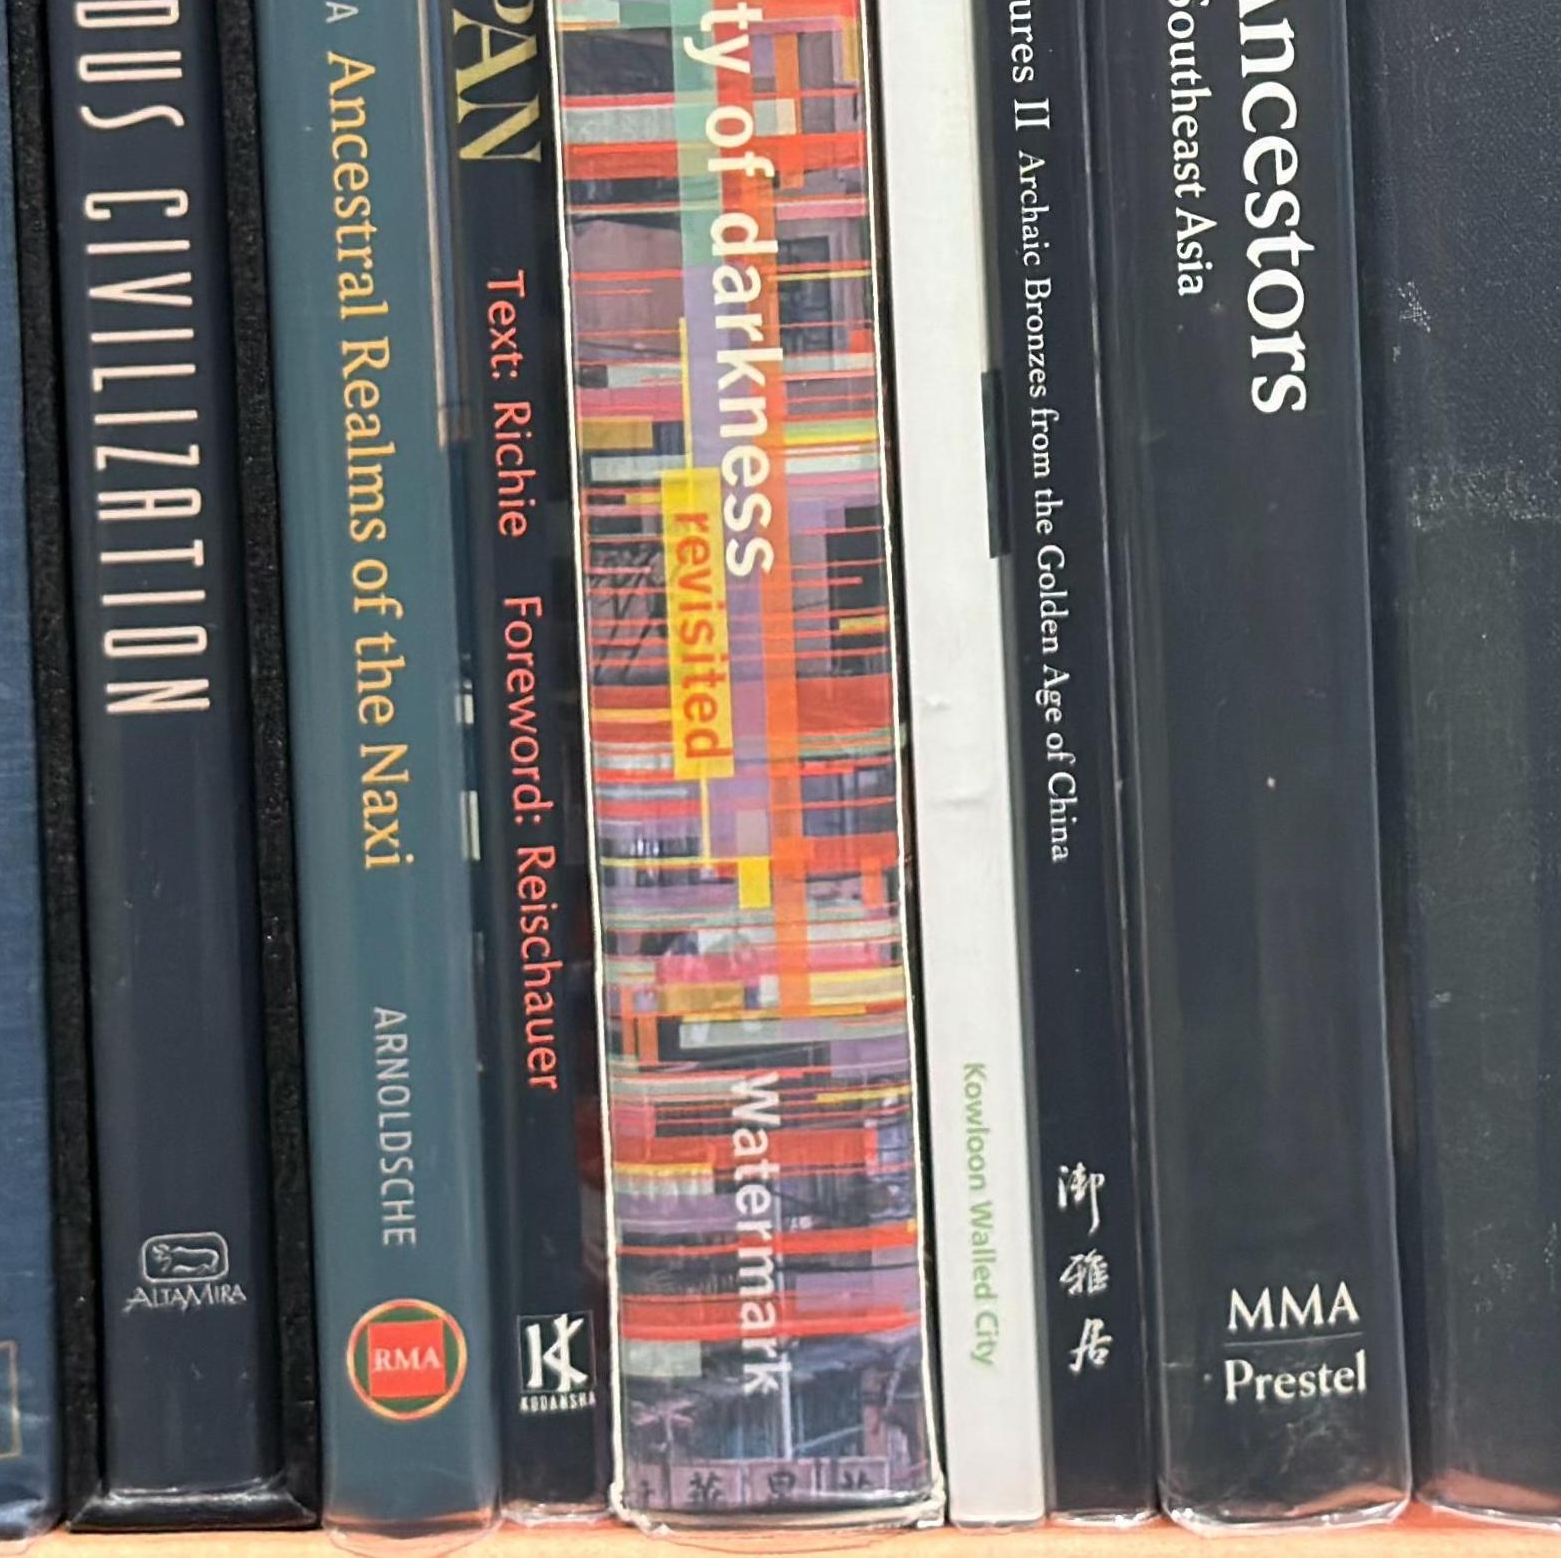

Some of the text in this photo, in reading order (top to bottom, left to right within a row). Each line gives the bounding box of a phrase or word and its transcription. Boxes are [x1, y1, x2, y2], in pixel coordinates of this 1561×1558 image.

[706, 104, 775, 179] of
[1013, 98, 1051, 131] II
[1174, 205, 1218, 297] Asia
[81, 186, 211, 716] CIVILIZATION
[325, 50, 415, 870] Ancestral Realms of the Naxi
[710, 211, 784, 578] darkness
[1018, 149, 1078, 863] Archaic Bronzes from the Golden Age of China
[486, 269, 563, 1091] Text: Richie Foreword: Reischauer
[372, 1006, 418, 1247] ARNOLDSCHE
[962, 1062, 1000, 1370] Kowloon Walled City
[374, 1344, 441, 1373] RMA
[1225, 1349, 1367, 1404] Prestel
[1227, 1280, 1361, 1332] MMA
[518, 1391, 598, 1414] KODANSHA
